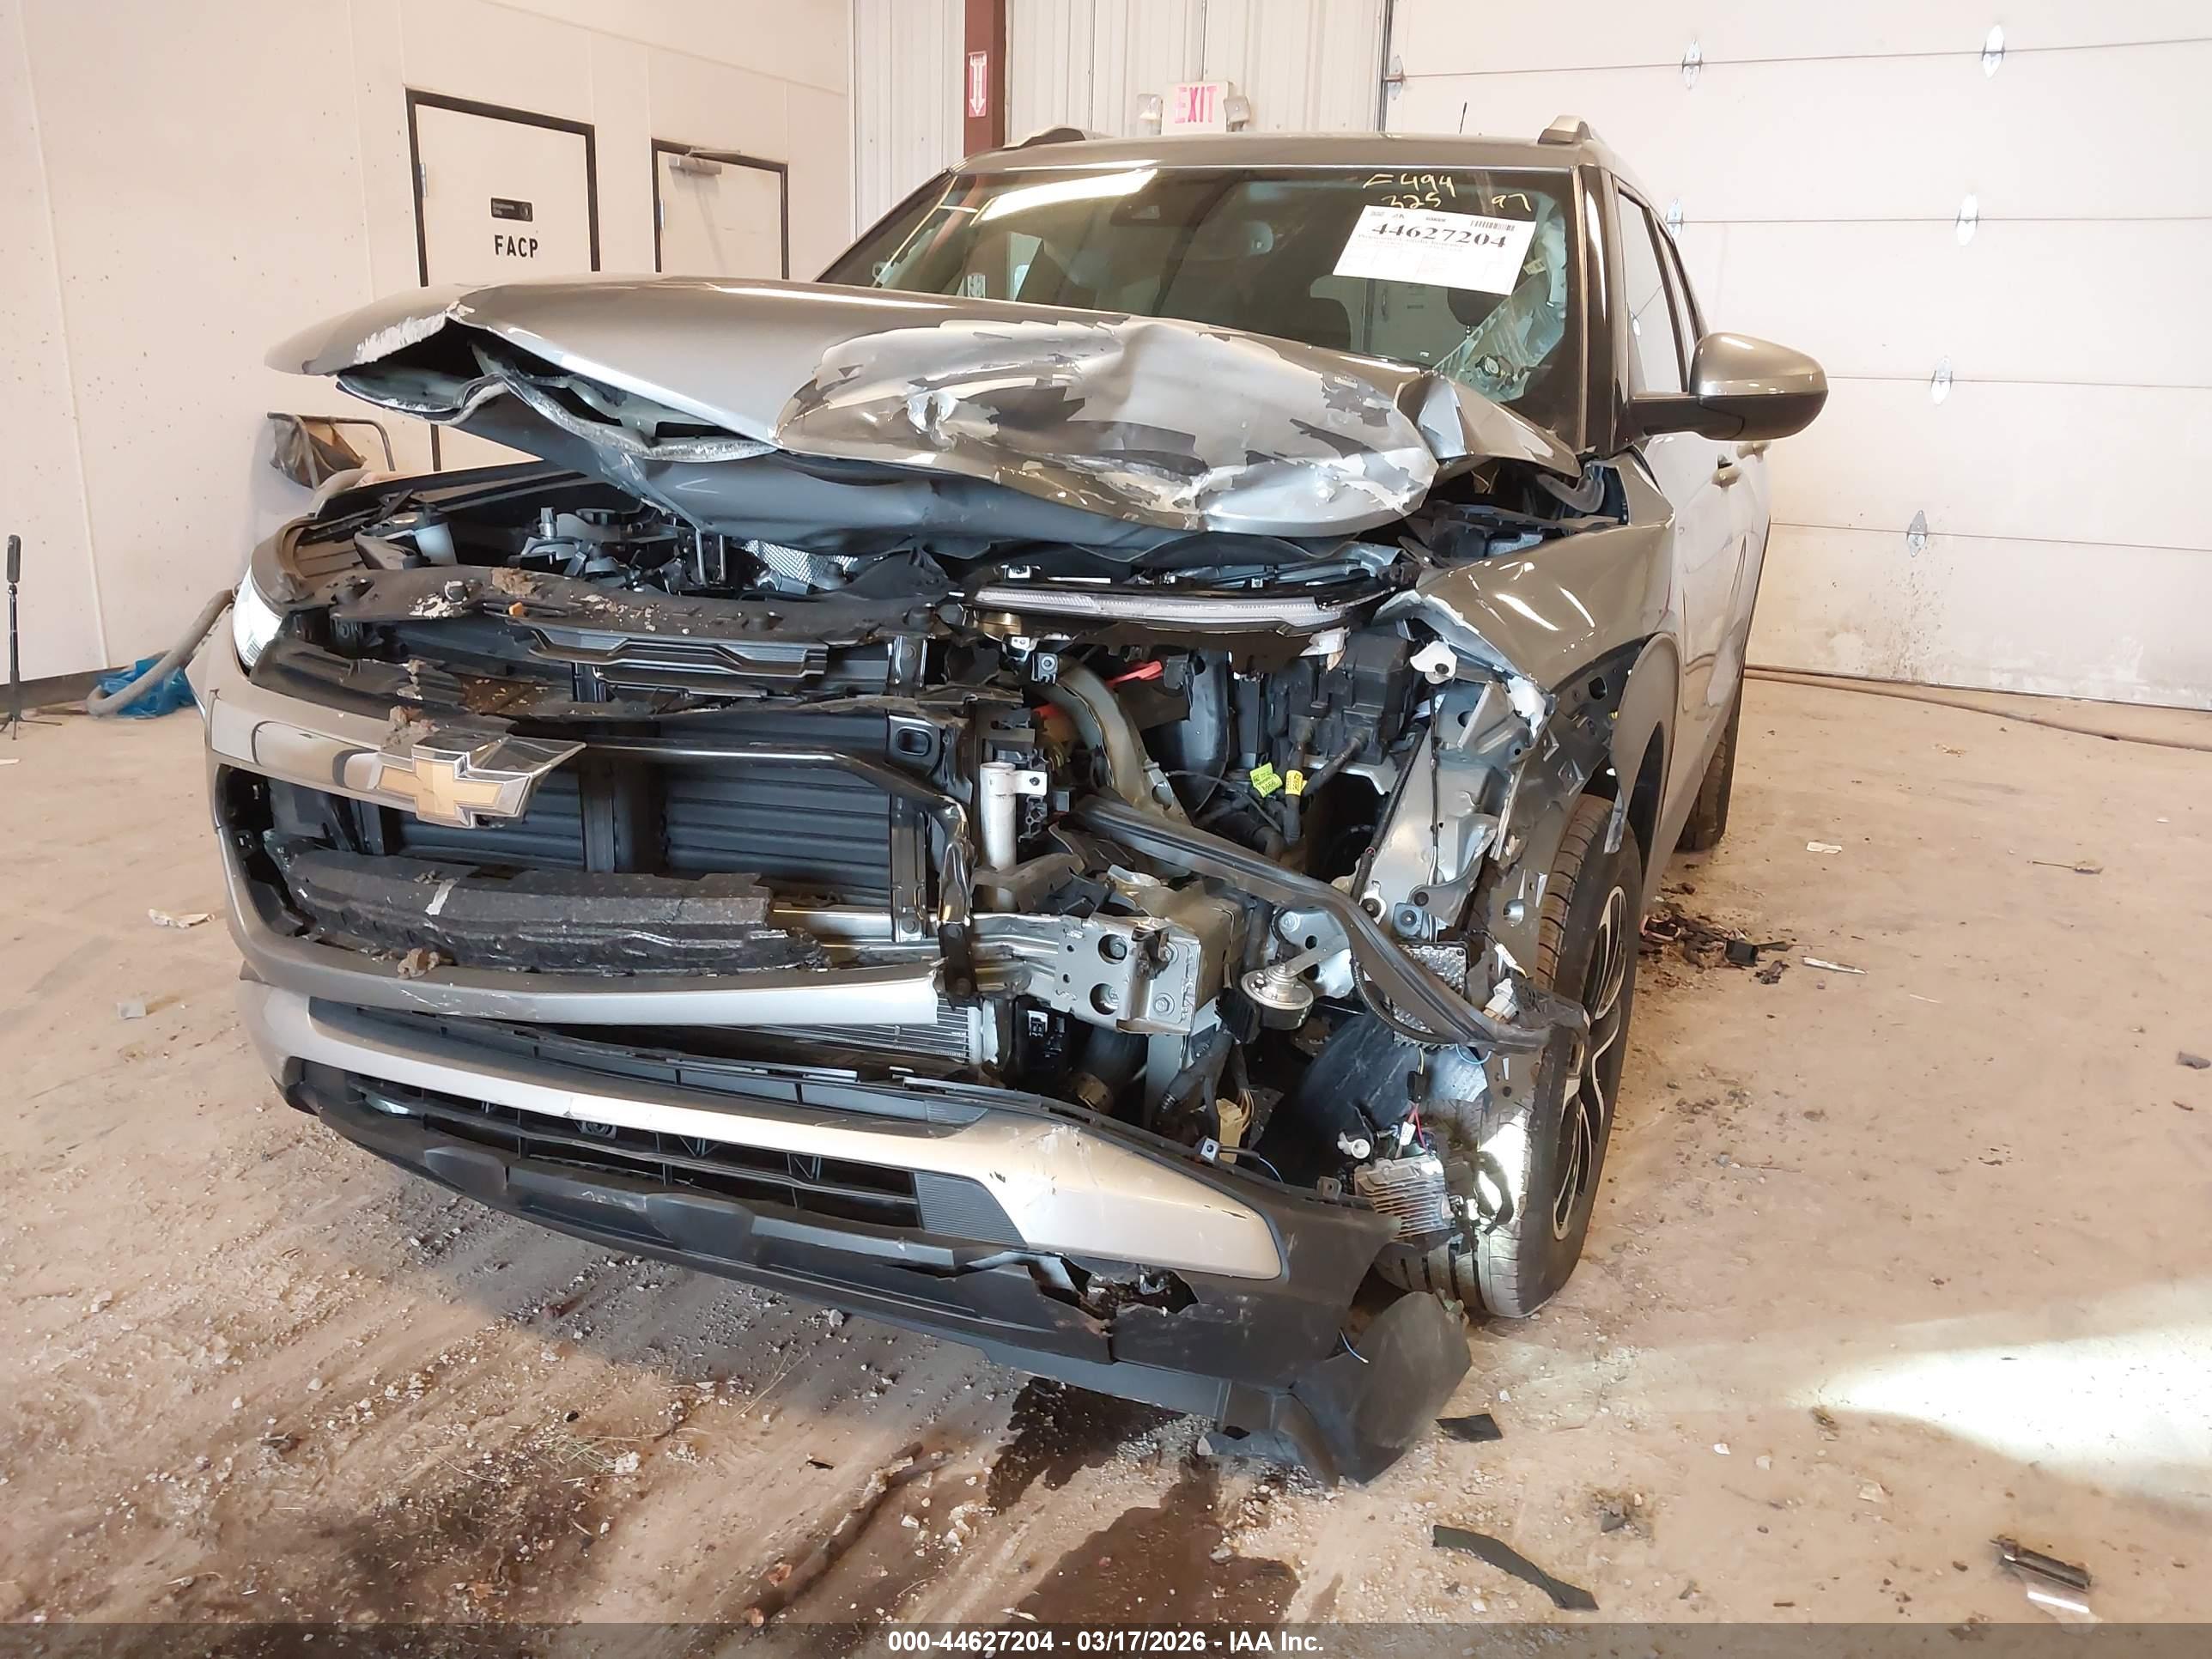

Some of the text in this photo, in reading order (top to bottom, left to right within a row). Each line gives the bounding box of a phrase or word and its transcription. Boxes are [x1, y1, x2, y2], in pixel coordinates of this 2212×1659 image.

[1175, 86, 1217, 124] EXIT
[494, 234, 538, 258] FACP
[1371, 222, 1506, 248] 44627204
